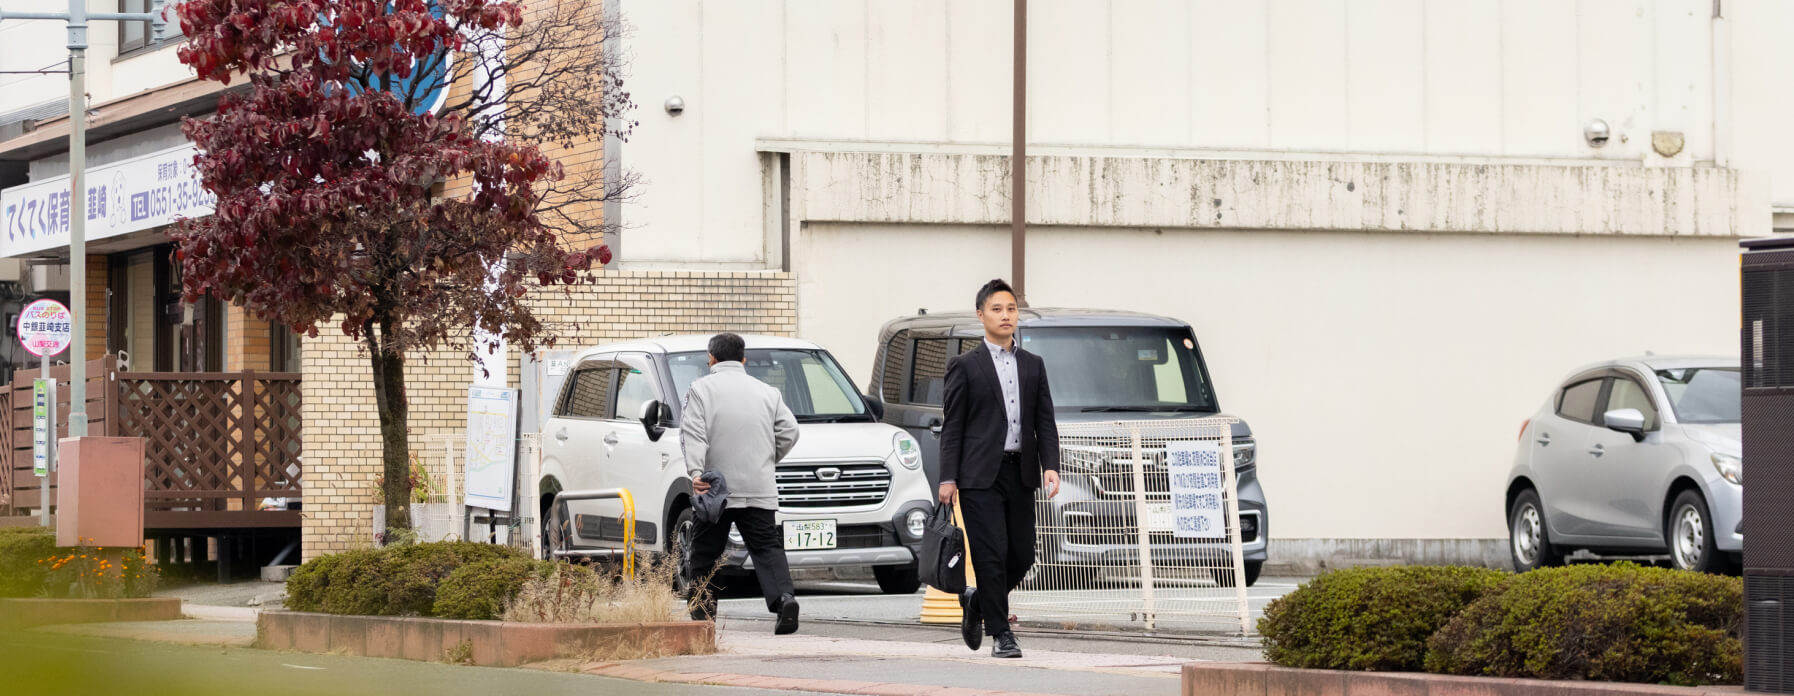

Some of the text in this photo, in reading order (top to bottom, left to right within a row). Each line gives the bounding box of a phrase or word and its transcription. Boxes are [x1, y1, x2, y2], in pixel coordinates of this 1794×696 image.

[6, 188, 71, 242] てくてく保育
[132, 196, 147, 219] TEL
[25, 311, 65, 320] バスのりば
[23, 321, 70, 332] 中銀韮崎支店
[797, 531, 834, 547] 17-12
